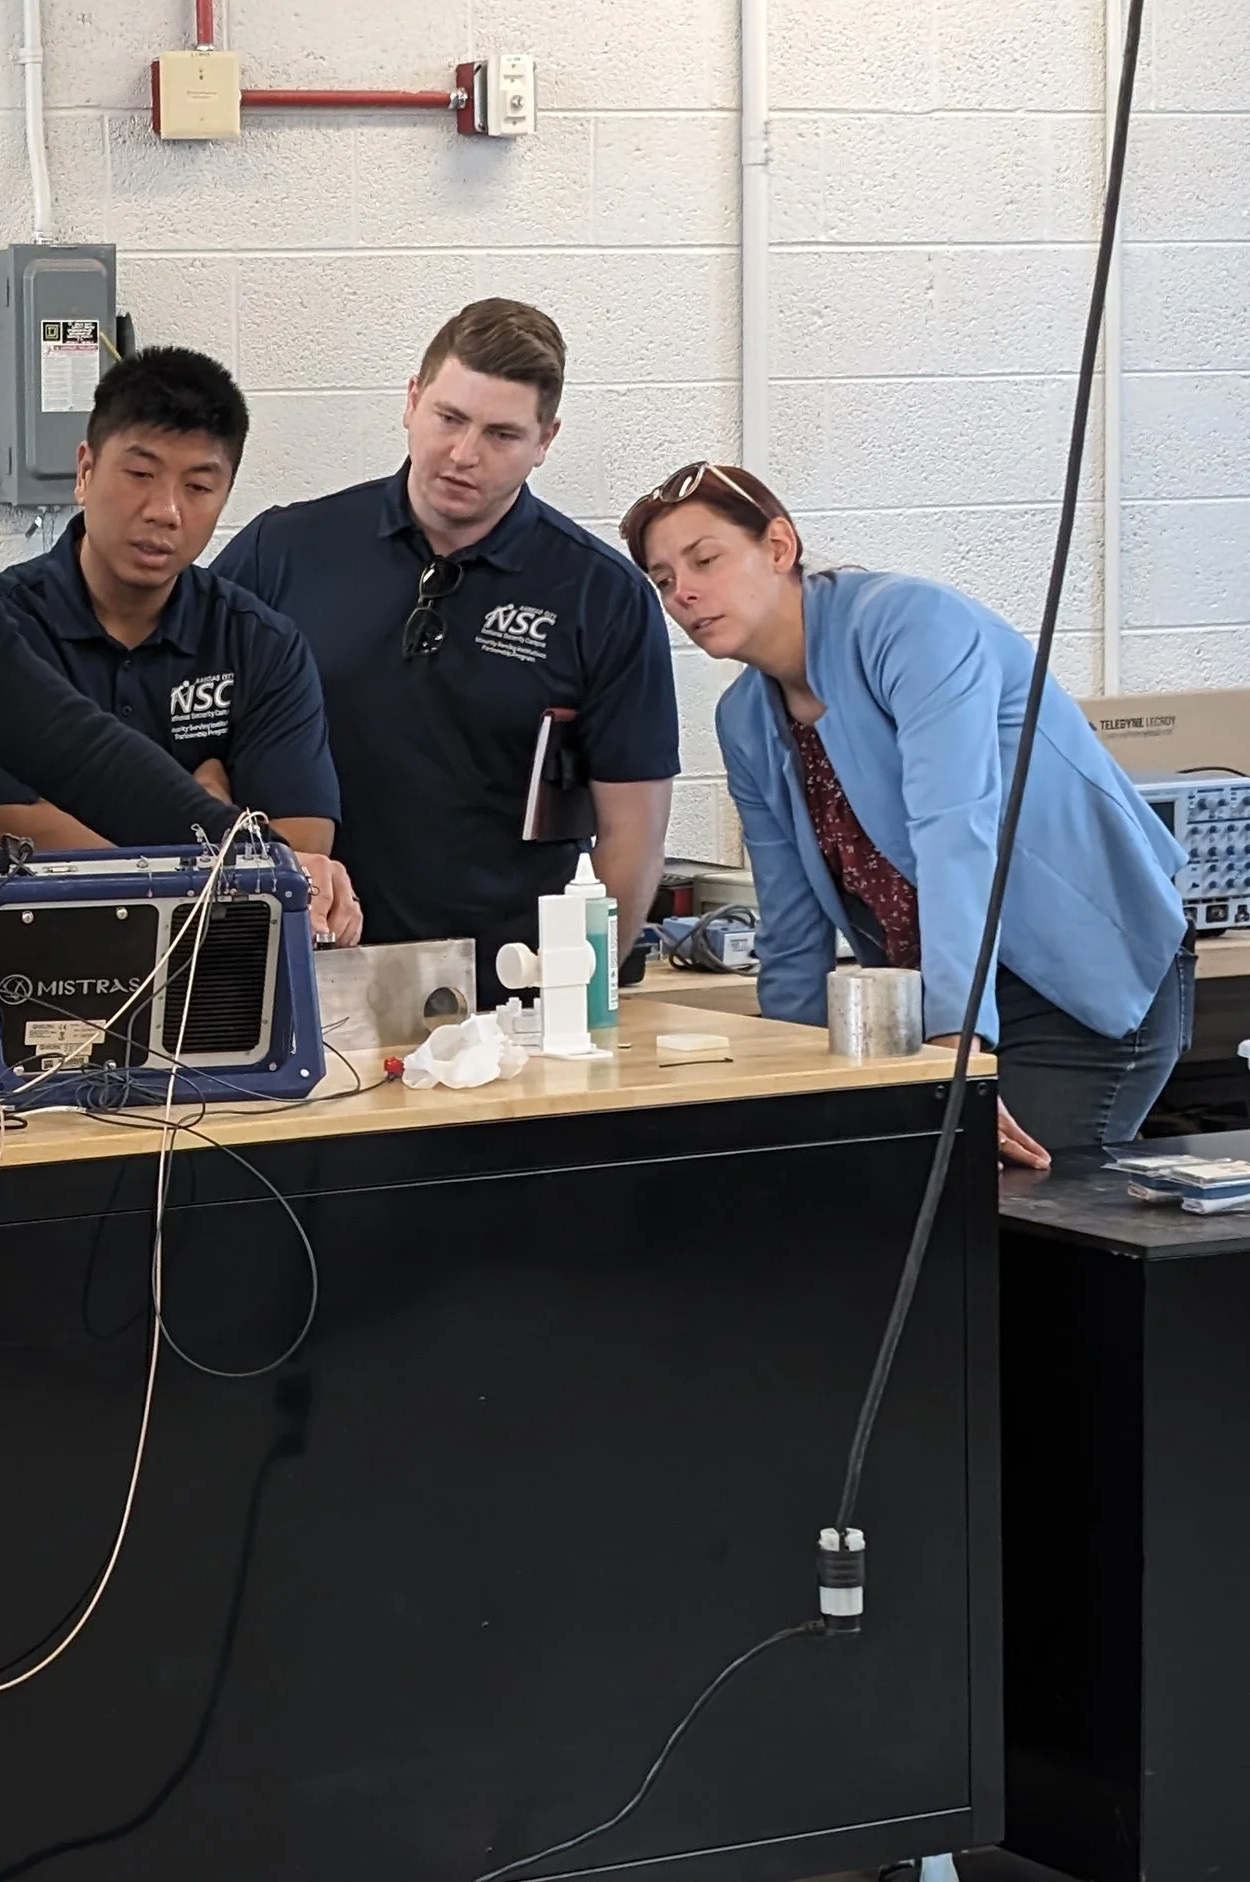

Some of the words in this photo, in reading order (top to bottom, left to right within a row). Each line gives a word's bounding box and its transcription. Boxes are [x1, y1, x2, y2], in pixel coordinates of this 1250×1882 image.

[483, 604, 556, 640] NSC
[170, 679, 234, 715] NSC
[1100, 717, 1144, 730] TELEDYNE
[37, 977, 141, 997] MISTRAS
